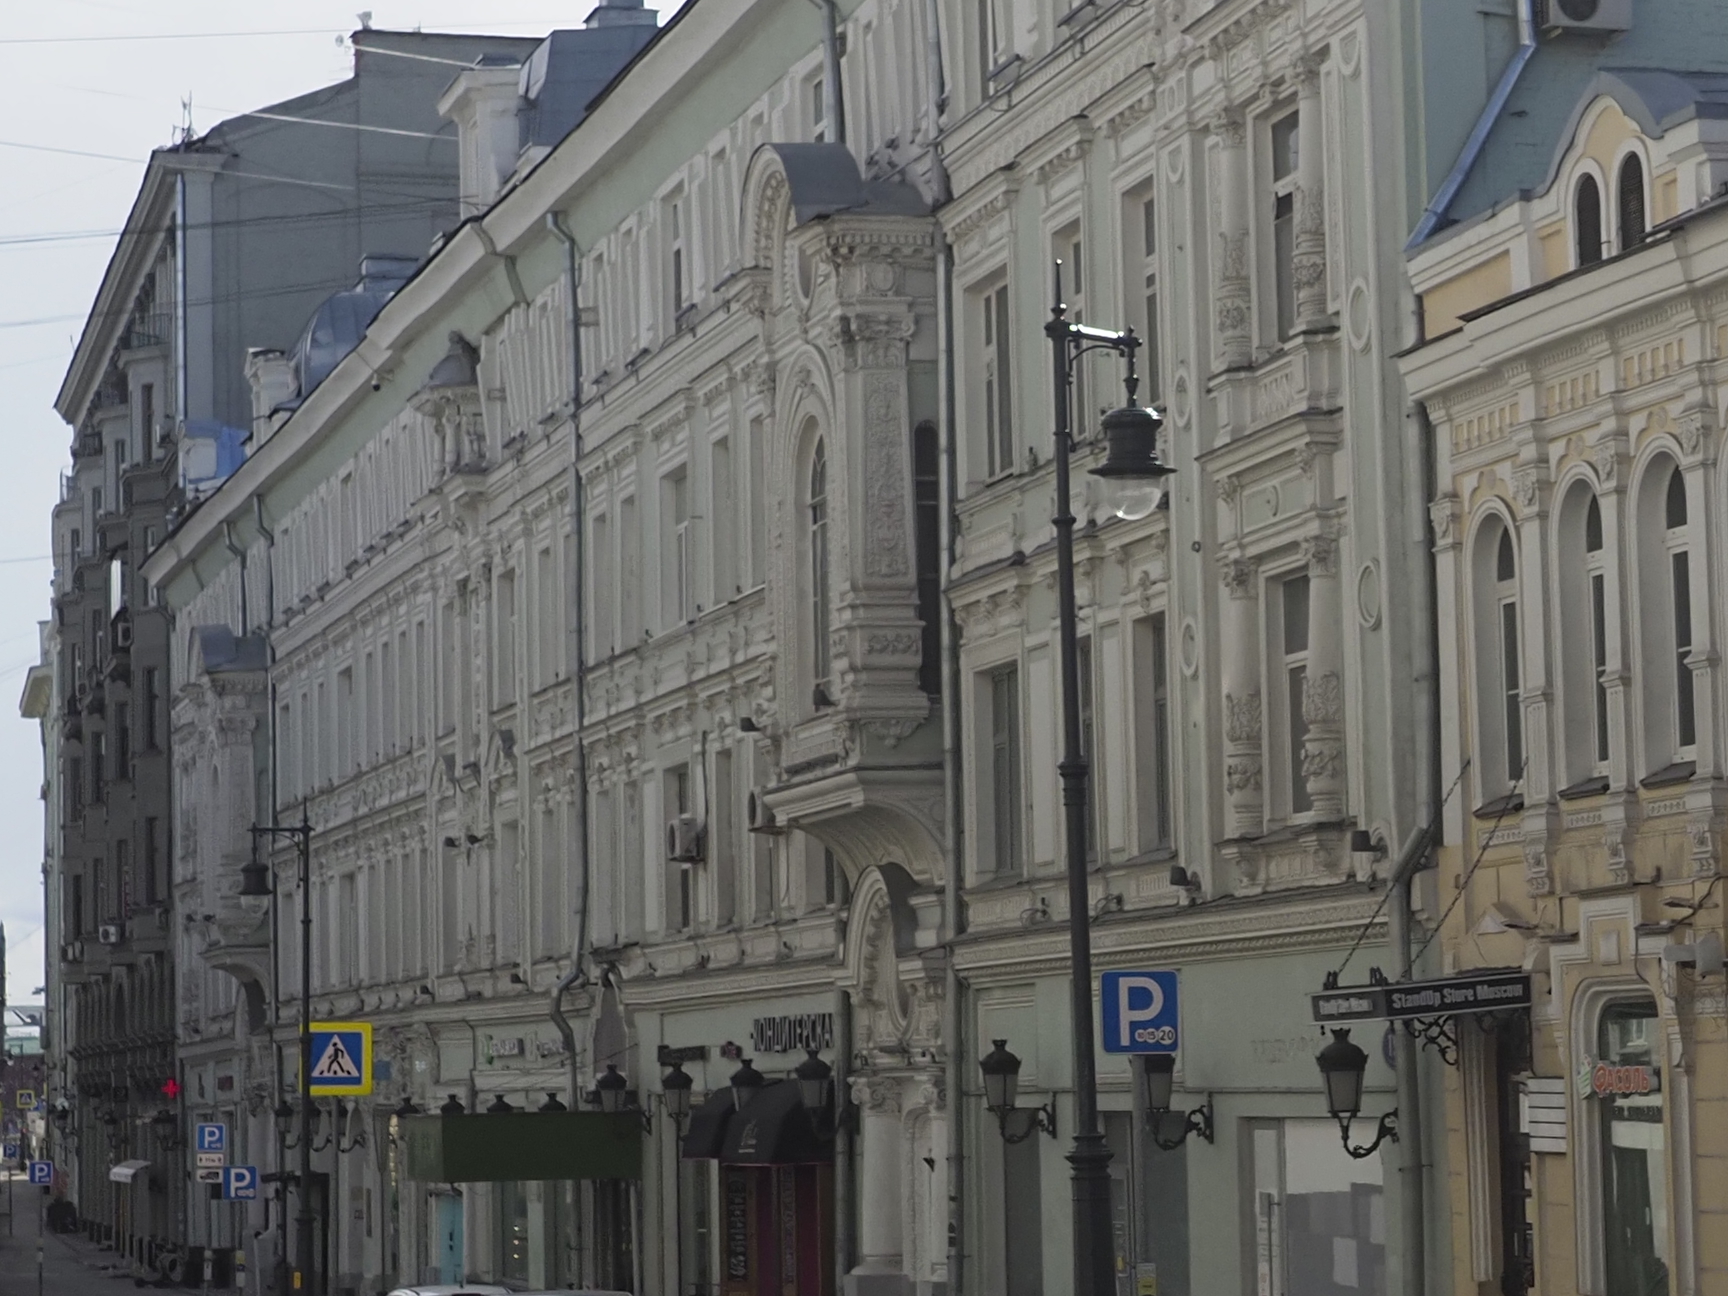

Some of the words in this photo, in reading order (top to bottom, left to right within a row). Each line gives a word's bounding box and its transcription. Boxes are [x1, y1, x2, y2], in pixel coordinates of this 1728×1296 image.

[1391, 989, 1441, 1009] StandUp
[1443, 988, 1474, 1003] Store
[1476, 984, 1523, 1000] Moscow
[1118, 976, 1164, 1046] P
[753, 1013, 835, 1053] КОНДИТЕРСКА
[1159, 1030, 1173, 1041] 20
[1593, 1064, 1650, 1098] ФАСОЛЬ
[204, 1127, 220, 1148] P
[35, 1163, 48, 1183] P
[230, 1168, 251, 1198] P
